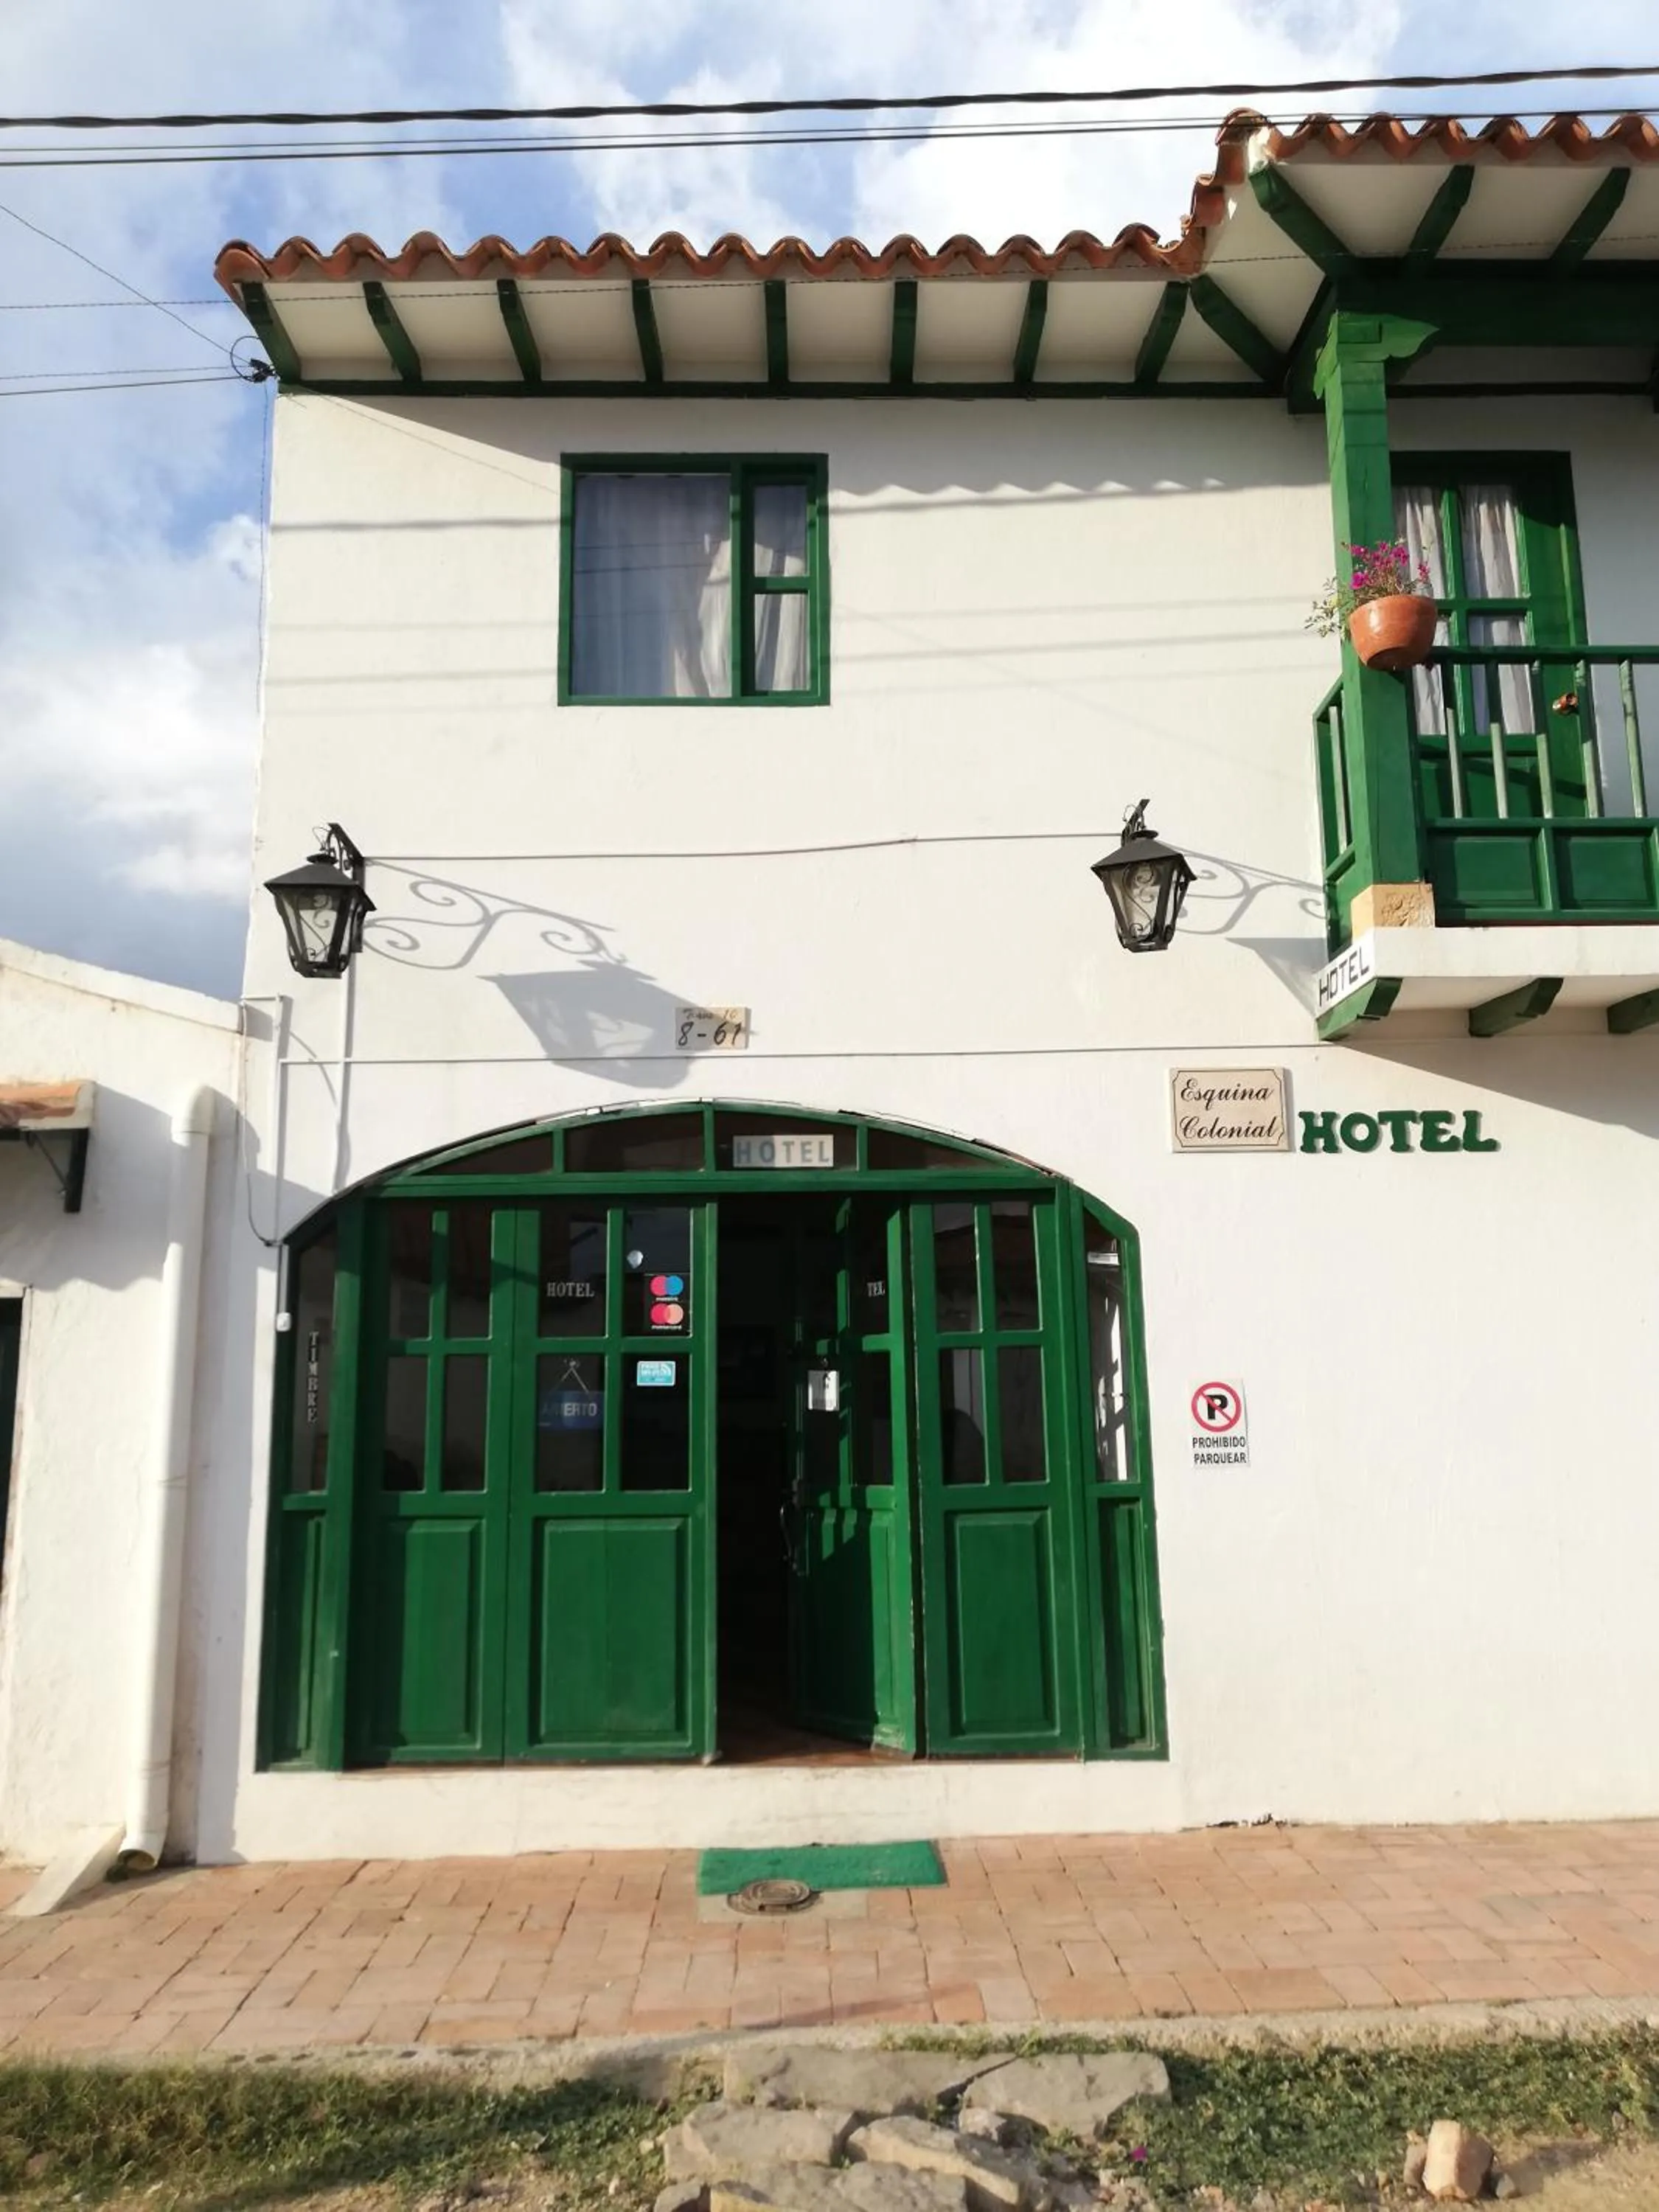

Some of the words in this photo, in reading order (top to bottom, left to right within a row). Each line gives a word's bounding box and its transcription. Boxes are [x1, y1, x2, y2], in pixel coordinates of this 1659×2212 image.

[1319, 945, 1369, 1007] HOTEL
[1180, 1079, 1274, 1110] Esquina
[1179, 1114, 1278, 1140] Colonial
[1298, 1110, 1498, 1153] HOTEL
[737, 1140, 830, 1164] HOTEL
[546, 1281, 595, 1298] HOTEL
[307, 1332, 319, 1425] TIMBRE
[1192, 1436, 1245, 1448] PROHIBIDO
[1194, 1453, 1246, 1464] PARQUEAR
